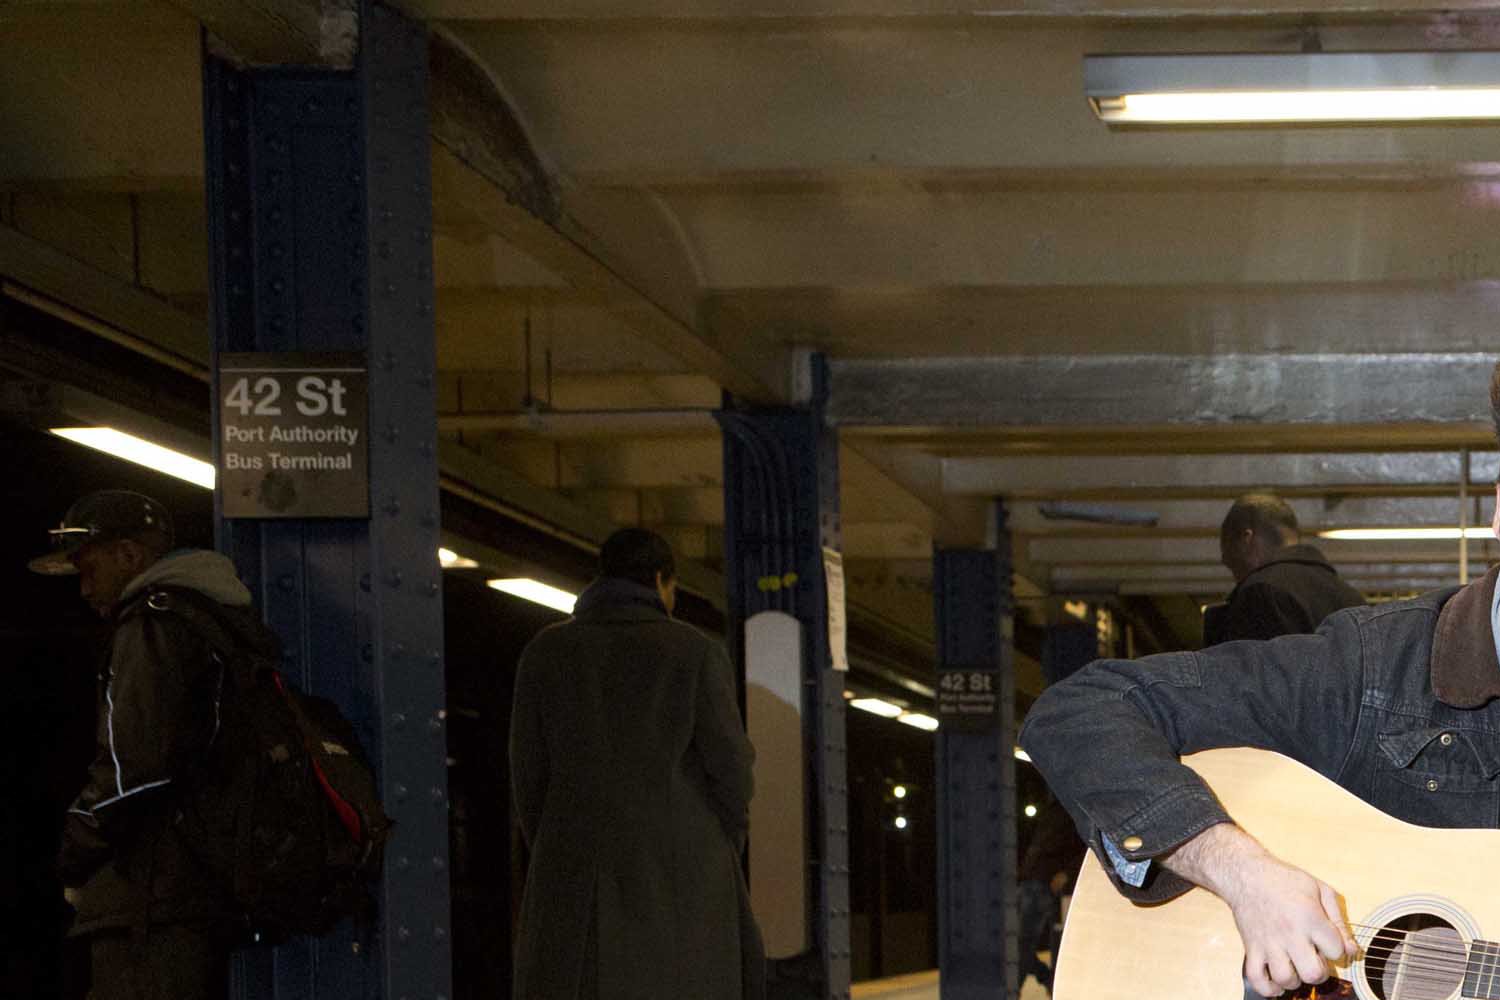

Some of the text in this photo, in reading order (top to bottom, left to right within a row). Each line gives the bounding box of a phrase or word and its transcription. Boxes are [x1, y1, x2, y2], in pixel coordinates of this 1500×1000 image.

[224, 375, 347, 418] 42 St
[225, 425, 359, 446] Port Authority
[226, 452, 353, 470] Bus Terminal
[940, 672, 991, 691] 42 St
